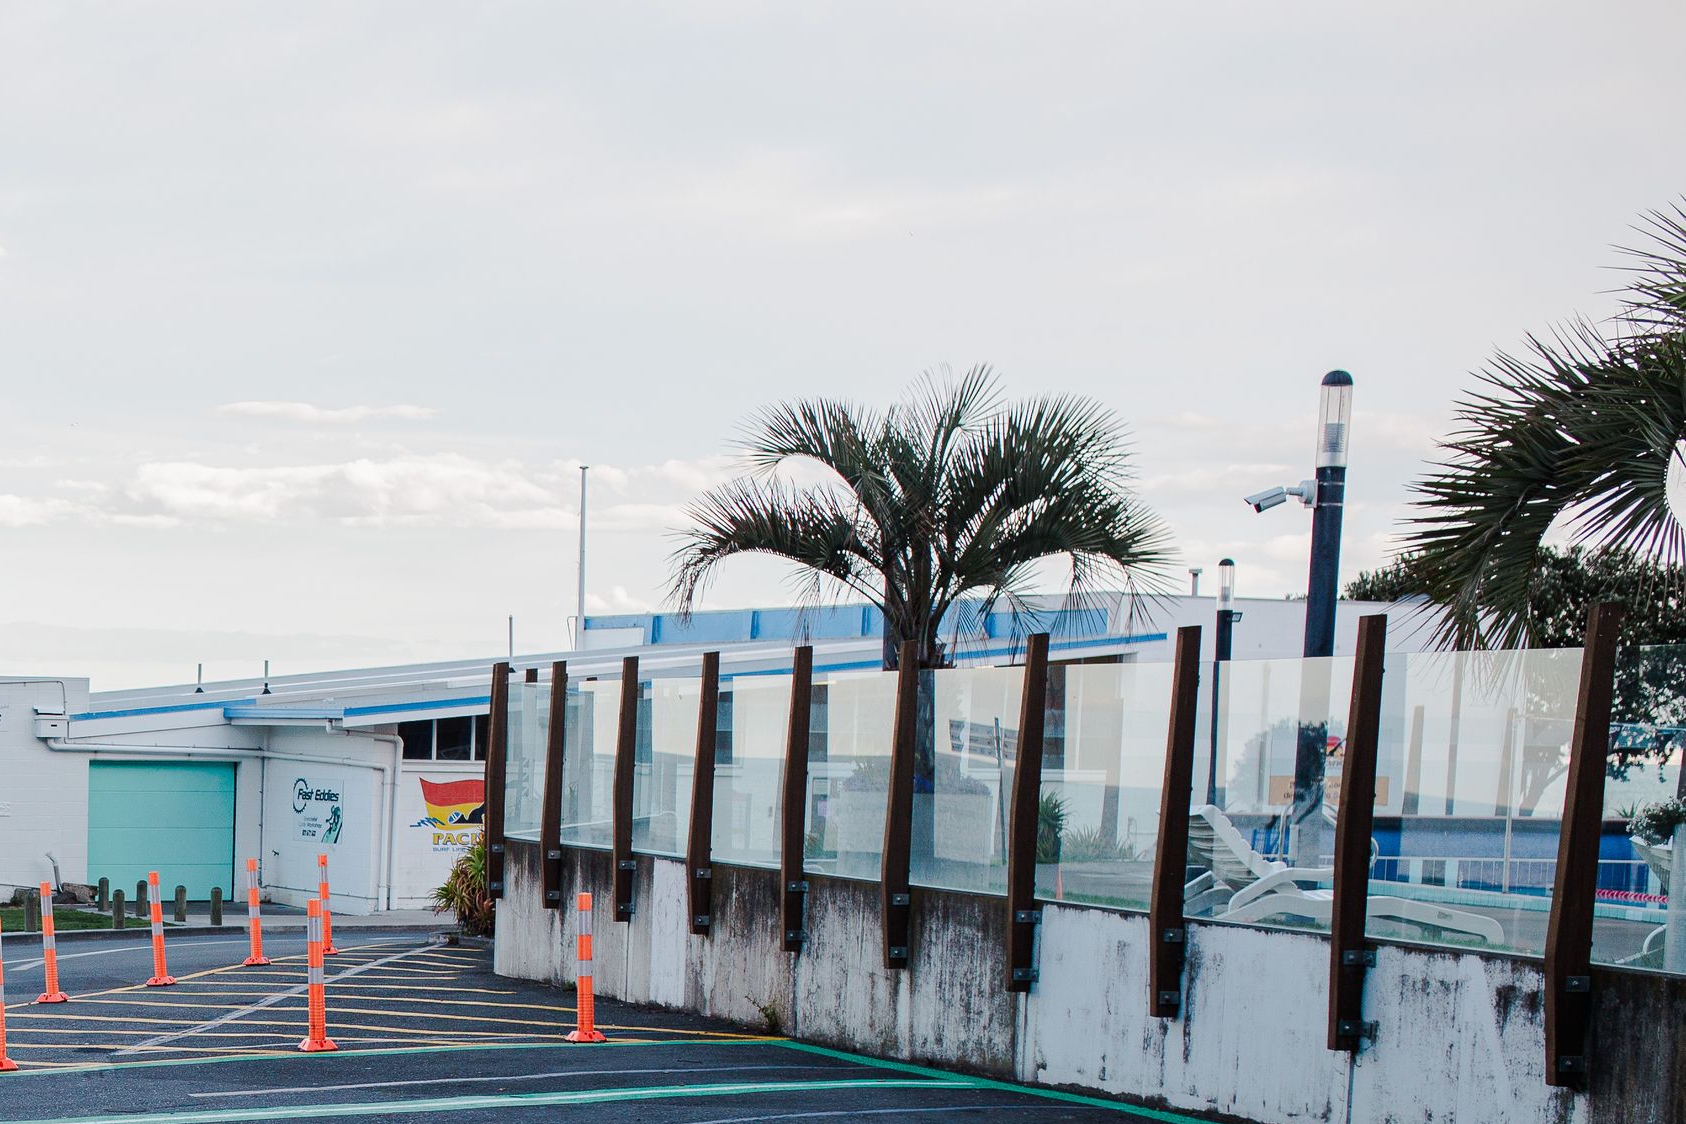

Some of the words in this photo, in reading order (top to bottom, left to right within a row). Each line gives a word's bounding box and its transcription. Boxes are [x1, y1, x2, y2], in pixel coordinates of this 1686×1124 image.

[297, 788, 314, 800] Fast
[314, 789, 340, 801] Eddies
[432, 833, 478, 846] PACI
